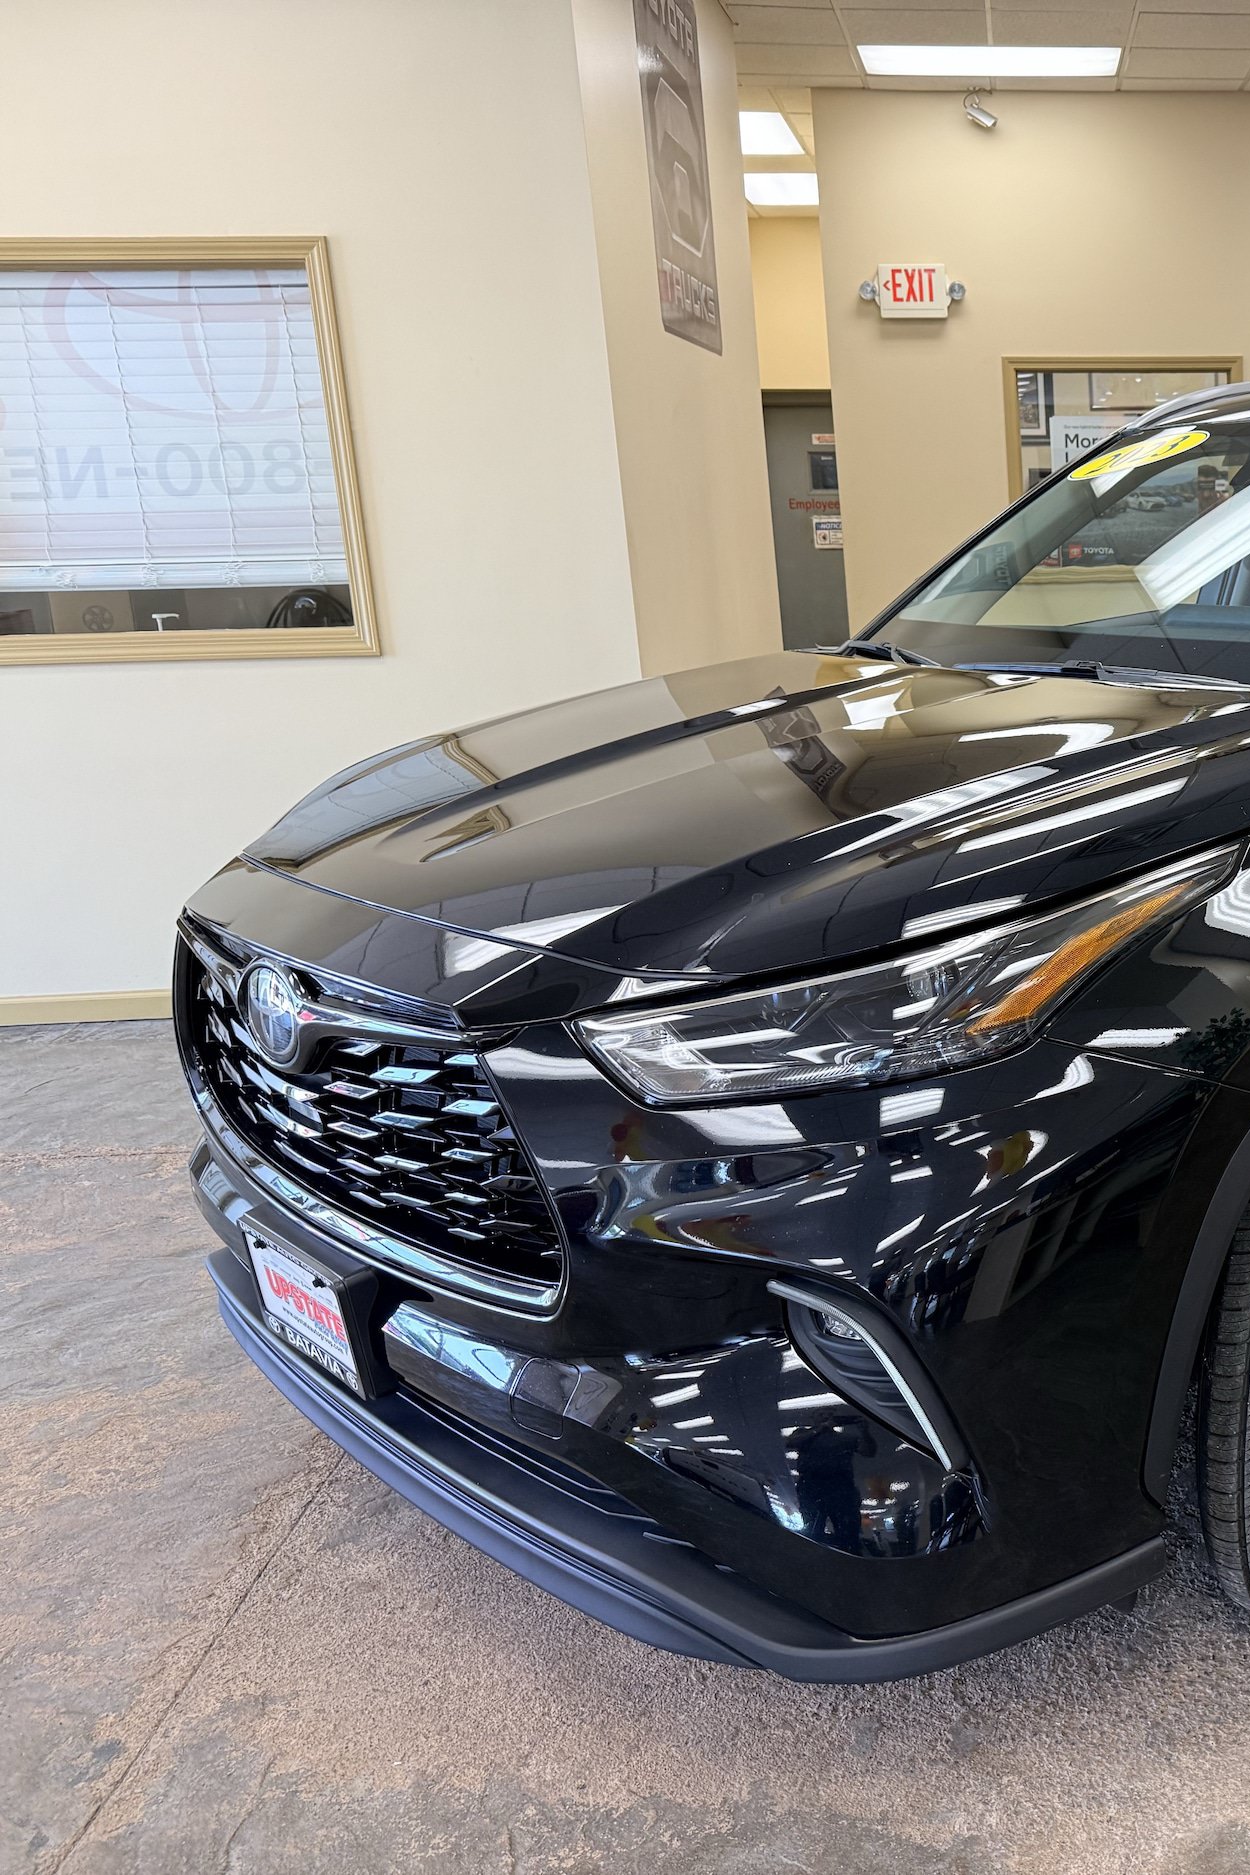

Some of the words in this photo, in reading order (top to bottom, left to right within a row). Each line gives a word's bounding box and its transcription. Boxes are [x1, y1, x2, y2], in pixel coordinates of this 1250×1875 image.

[662, 258, 716, 325] TRUCKS
[891, 268, 936, 302] EXIT
[1065, 433, 1103, 449] Mor
[1083, 547, 1114, 555] TOYOTA
[264, 1265, 347, 1342] UPSTATE
[285, 1327, 345, 1381] BATAVIA
